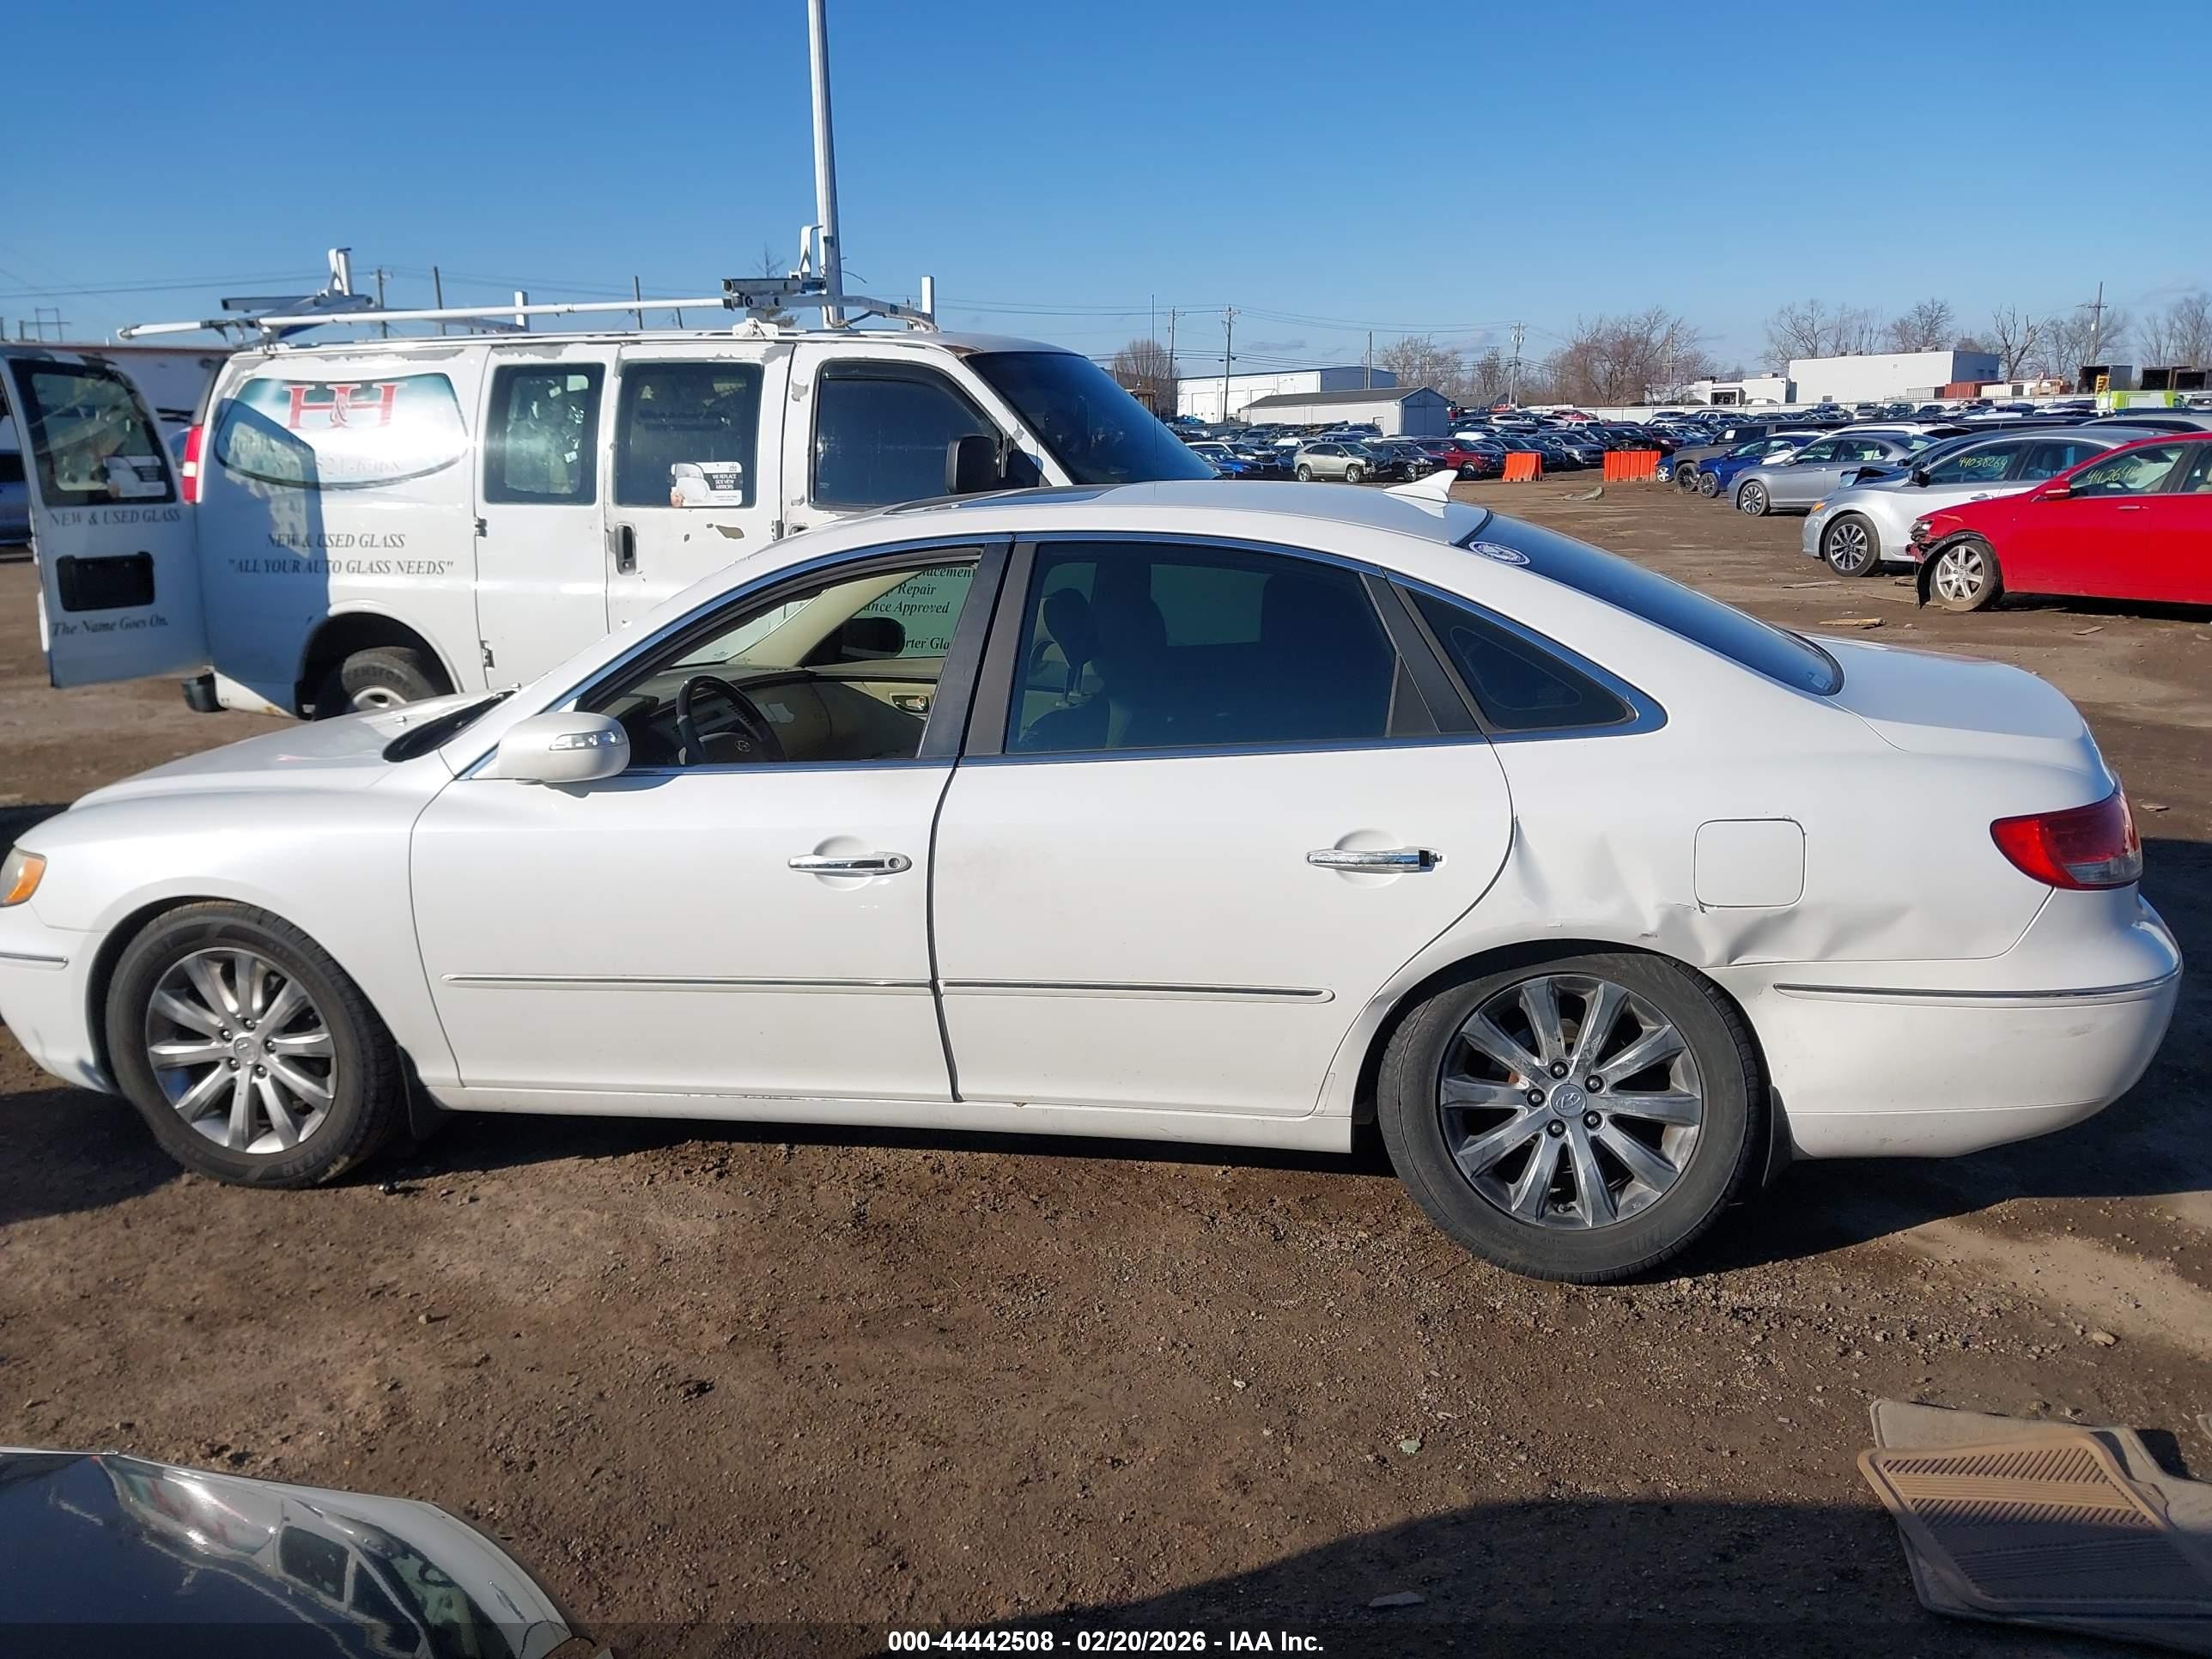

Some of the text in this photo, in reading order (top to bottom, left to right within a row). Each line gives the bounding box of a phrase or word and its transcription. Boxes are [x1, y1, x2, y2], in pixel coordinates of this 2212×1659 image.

[283, 383, 408, 429] H&H
[49, 508, 180, 526] NEW & USED GLASS
[268, 533, 405, 548] NEW & USED GLASS
[264, 559, 301, 574] YOUR
[304, 559, 342, 574] AUTO
[346, 560, 391, 574] GLASS
[897, 583, 937, 598] Repair
[863, 601, 951, 616] ance Approved
[52, 622, 77, 637] The
[82, 619, 117, 634] Name
[119, 616, 147, 629] Goes
[905, 637, 950, 650] rter Gla
